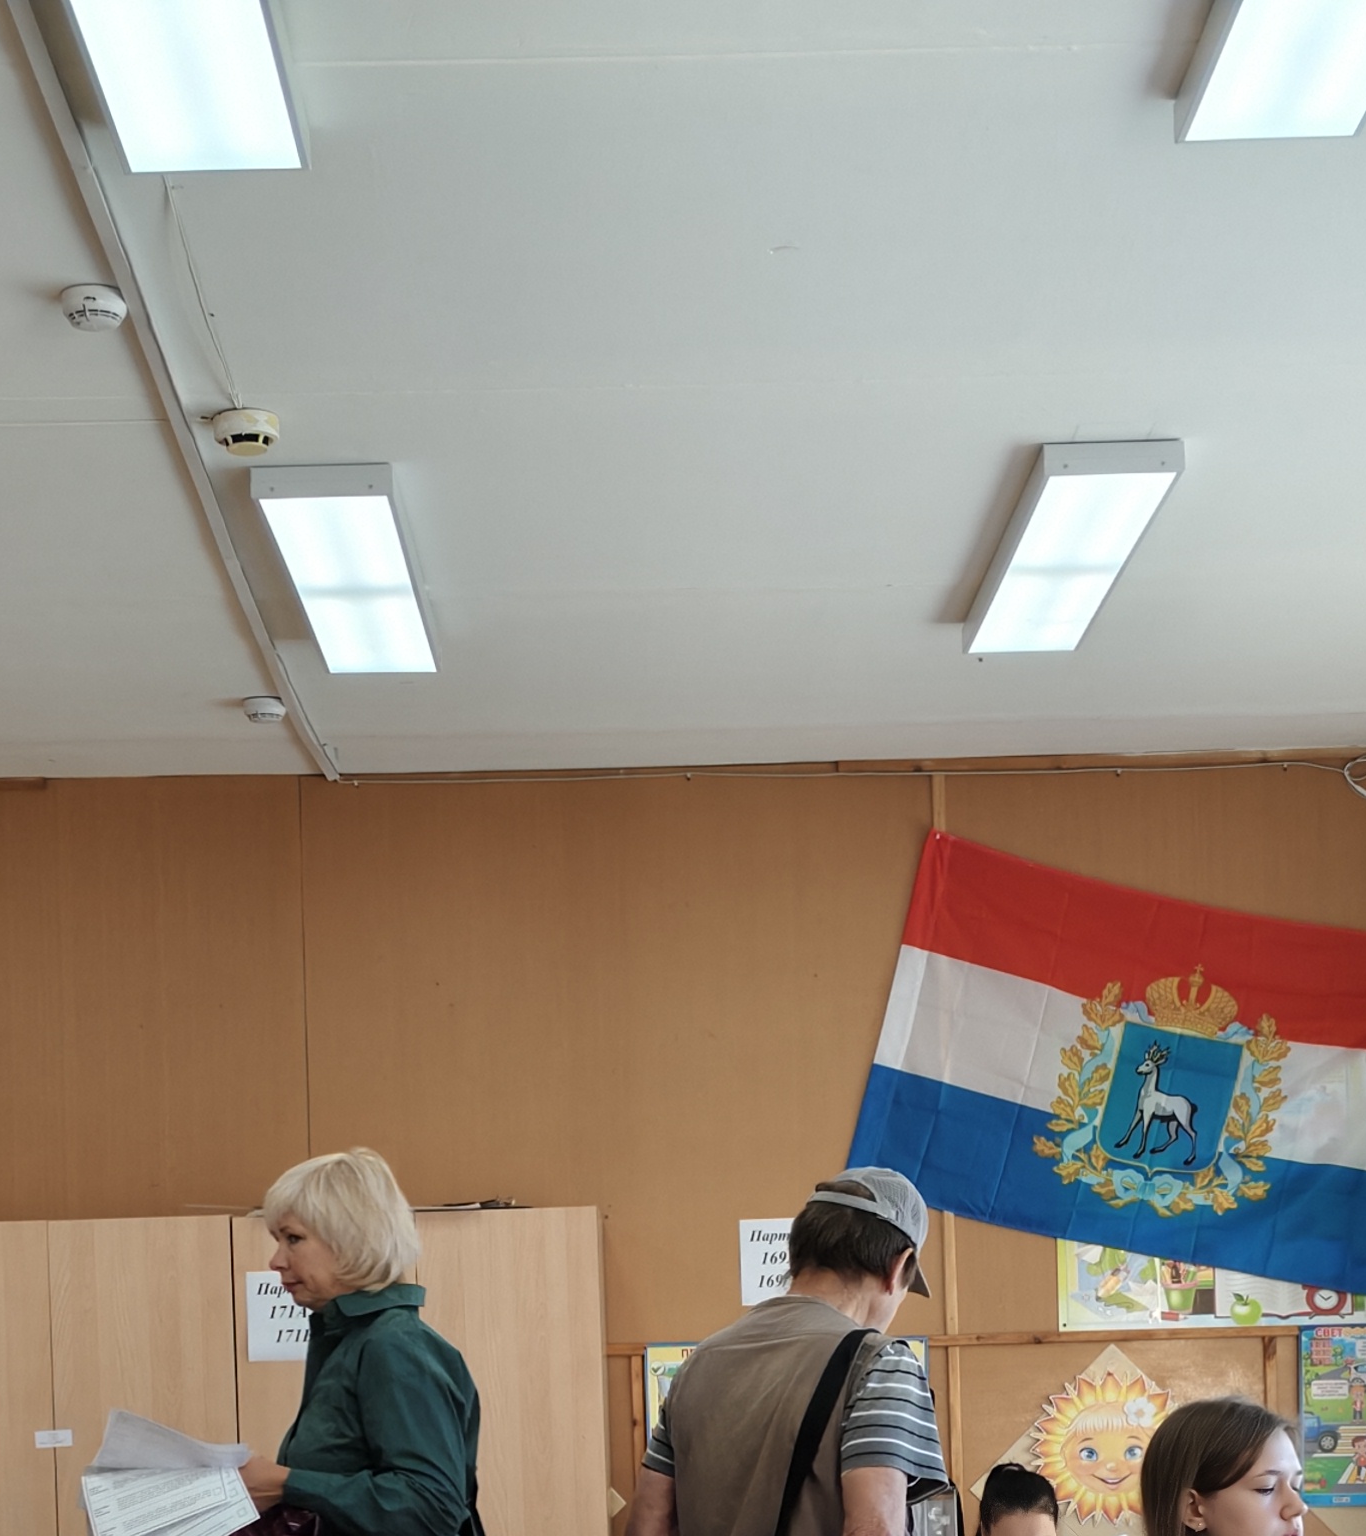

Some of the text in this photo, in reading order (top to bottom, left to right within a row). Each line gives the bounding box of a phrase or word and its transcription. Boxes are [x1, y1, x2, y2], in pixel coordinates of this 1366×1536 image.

[762, 1250, 790, 1265] 169
[758, 1274, 785, 1288] 169
[681, 1348, 696, 1359] П
